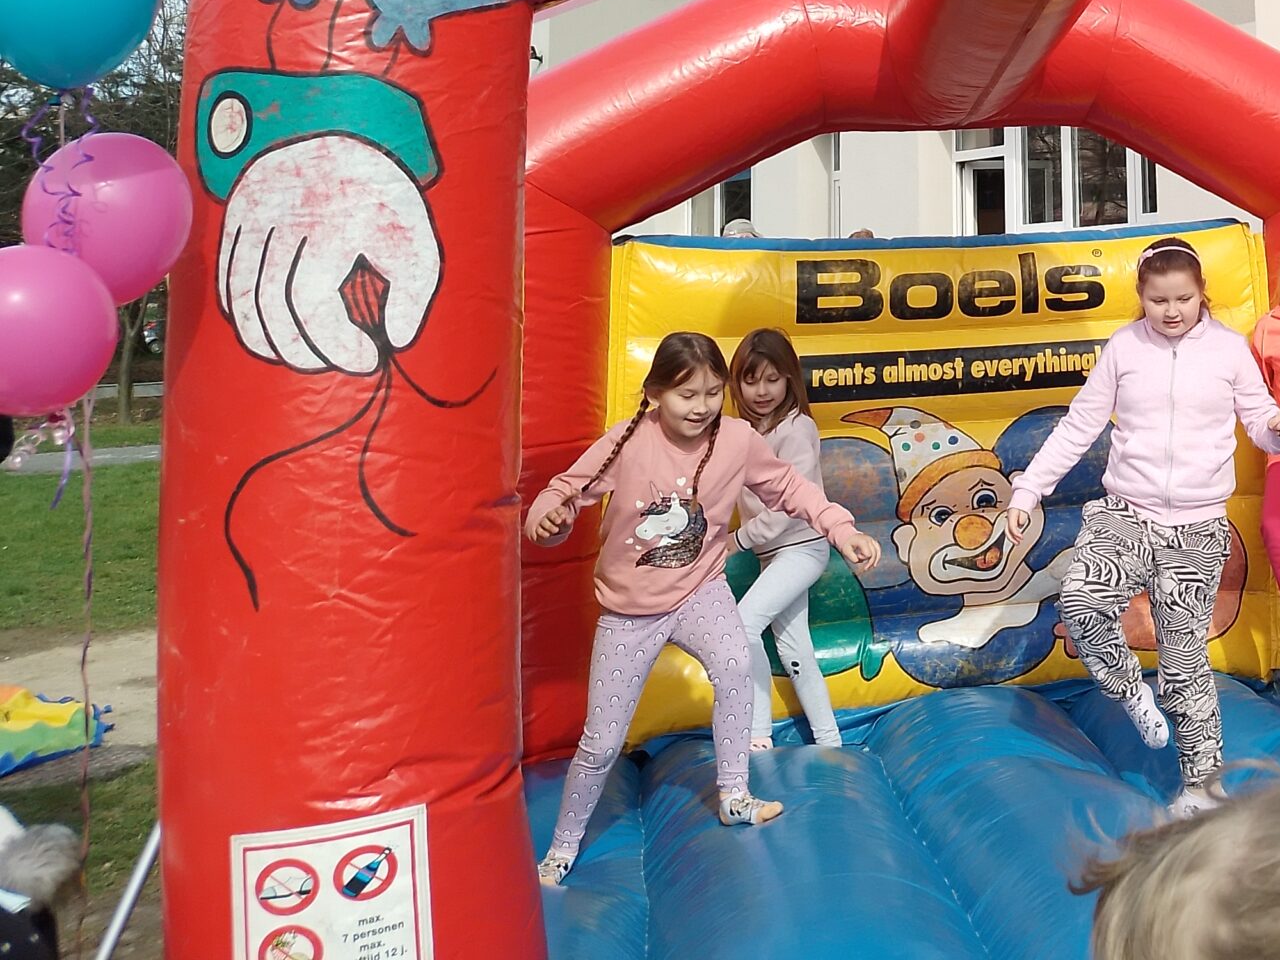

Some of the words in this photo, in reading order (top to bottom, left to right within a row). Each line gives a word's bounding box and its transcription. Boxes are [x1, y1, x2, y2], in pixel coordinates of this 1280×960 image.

[795, 252, 1106, 324] Boels
[812, 362, 876, 387] rents
[883, 357, 964, 384] almost
[358, 915, 384, 927] max.
[342, 933, 349, 943] 7
[353, 921, 404, 942] personen
[360, 940, 385, 952] max.
[385, 947, 398, 958] 12
